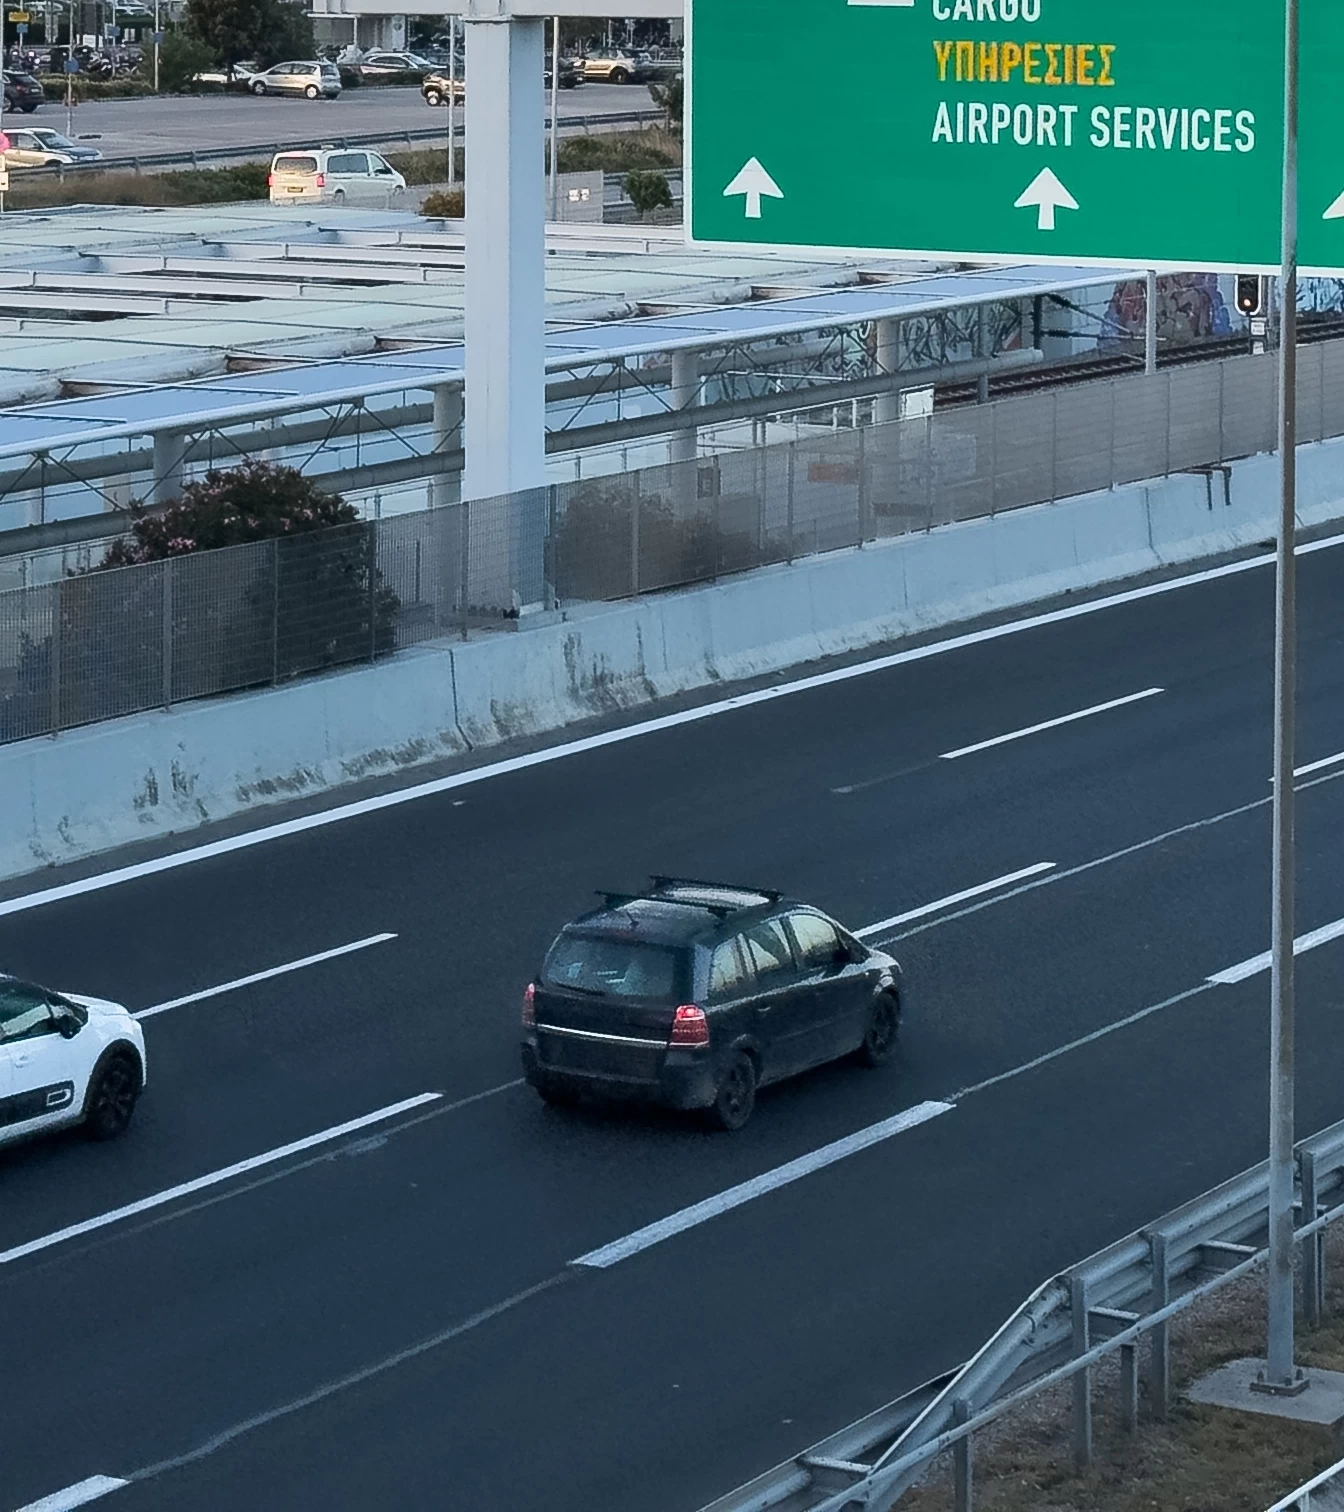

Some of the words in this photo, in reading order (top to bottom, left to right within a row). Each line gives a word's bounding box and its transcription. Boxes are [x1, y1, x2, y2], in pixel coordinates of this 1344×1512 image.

[933, 39, 1117, 87] ΥΠΗΡΕΣΙΕΣ
[932, 101, 1079, 147] AIRPORT
[1090, 105, 1256, 153] SERVICES
